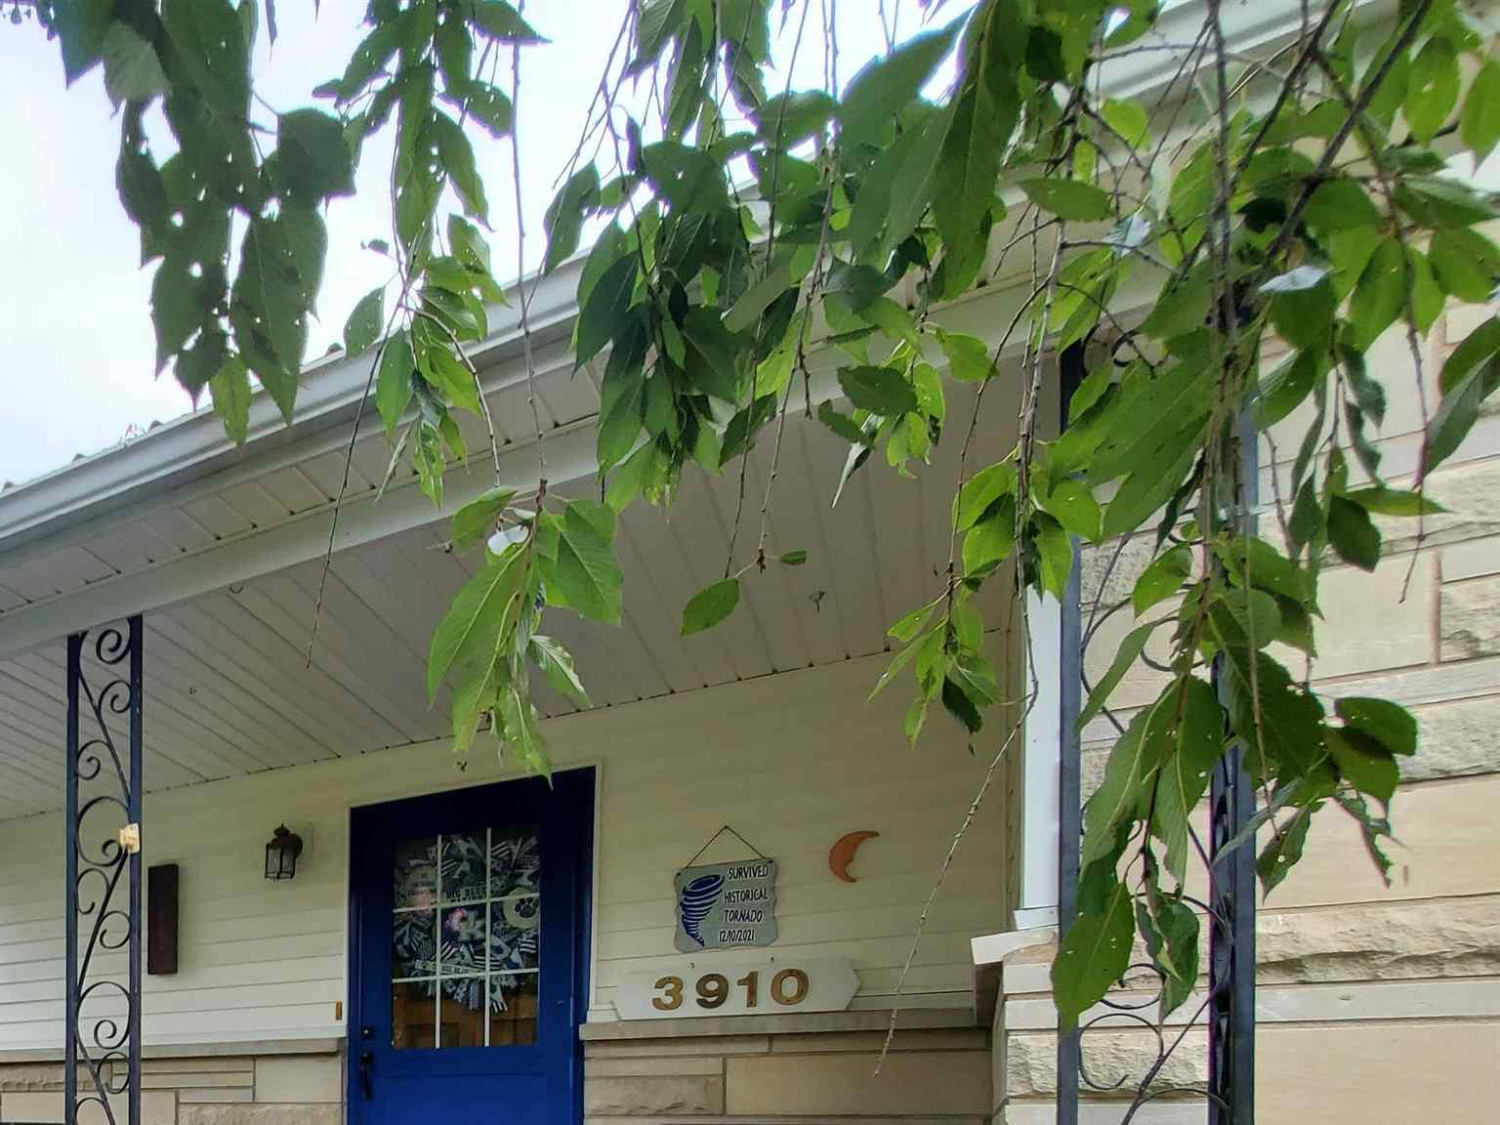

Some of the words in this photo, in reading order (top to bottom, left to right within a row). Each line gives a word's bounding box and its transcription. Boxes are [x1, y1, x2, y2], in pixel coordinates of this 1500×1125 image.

[728, 865, 769, 880] SURVIVED
[724, 888, 768, 903] HISTORICAL
[724, 909, 763, 923] TORNADO
[719, 929, 755, 943] 12/10/2021
[652, 968, 809, 1011] 3910
